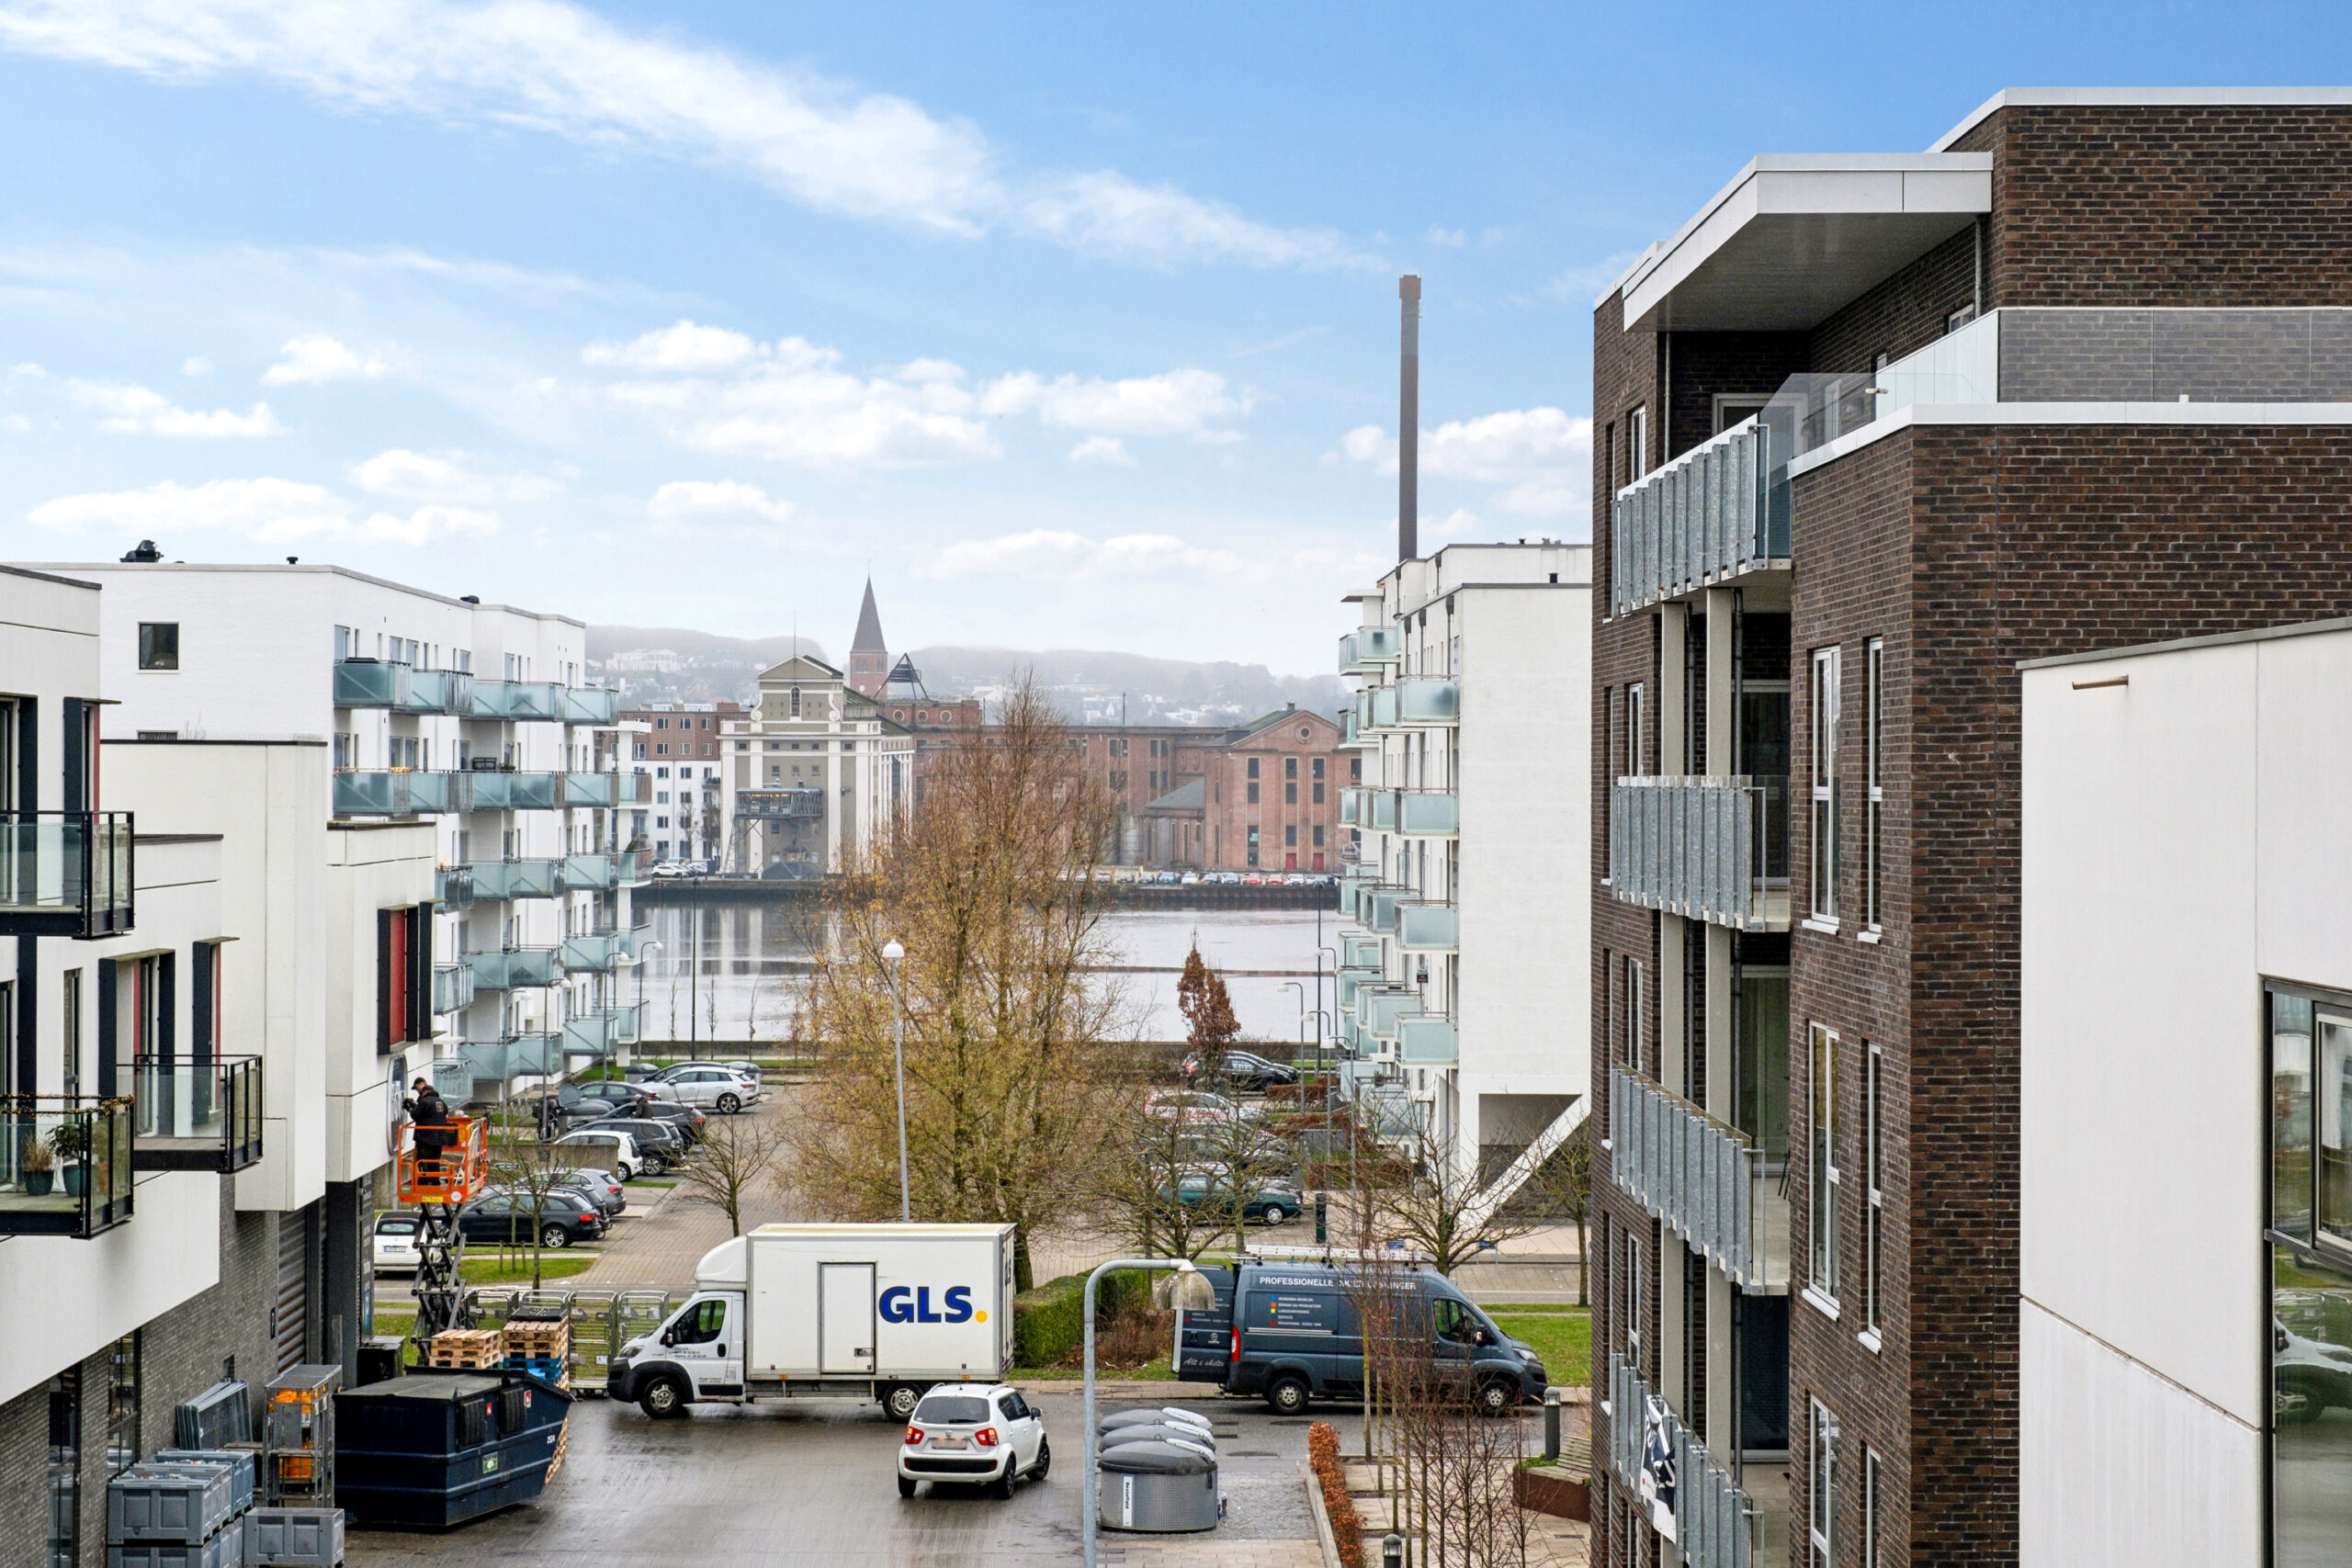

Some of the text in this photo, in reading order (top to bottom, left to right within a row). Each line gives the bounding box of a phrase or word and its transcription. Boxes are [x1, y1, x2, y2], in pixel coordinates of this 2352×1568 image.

[1259, 1277, 1334, 1287] PROFESSIONELLE
[1182, 1358, 1198, 1366] Alt
[1204, 1359, 1226, 1367] skilte
